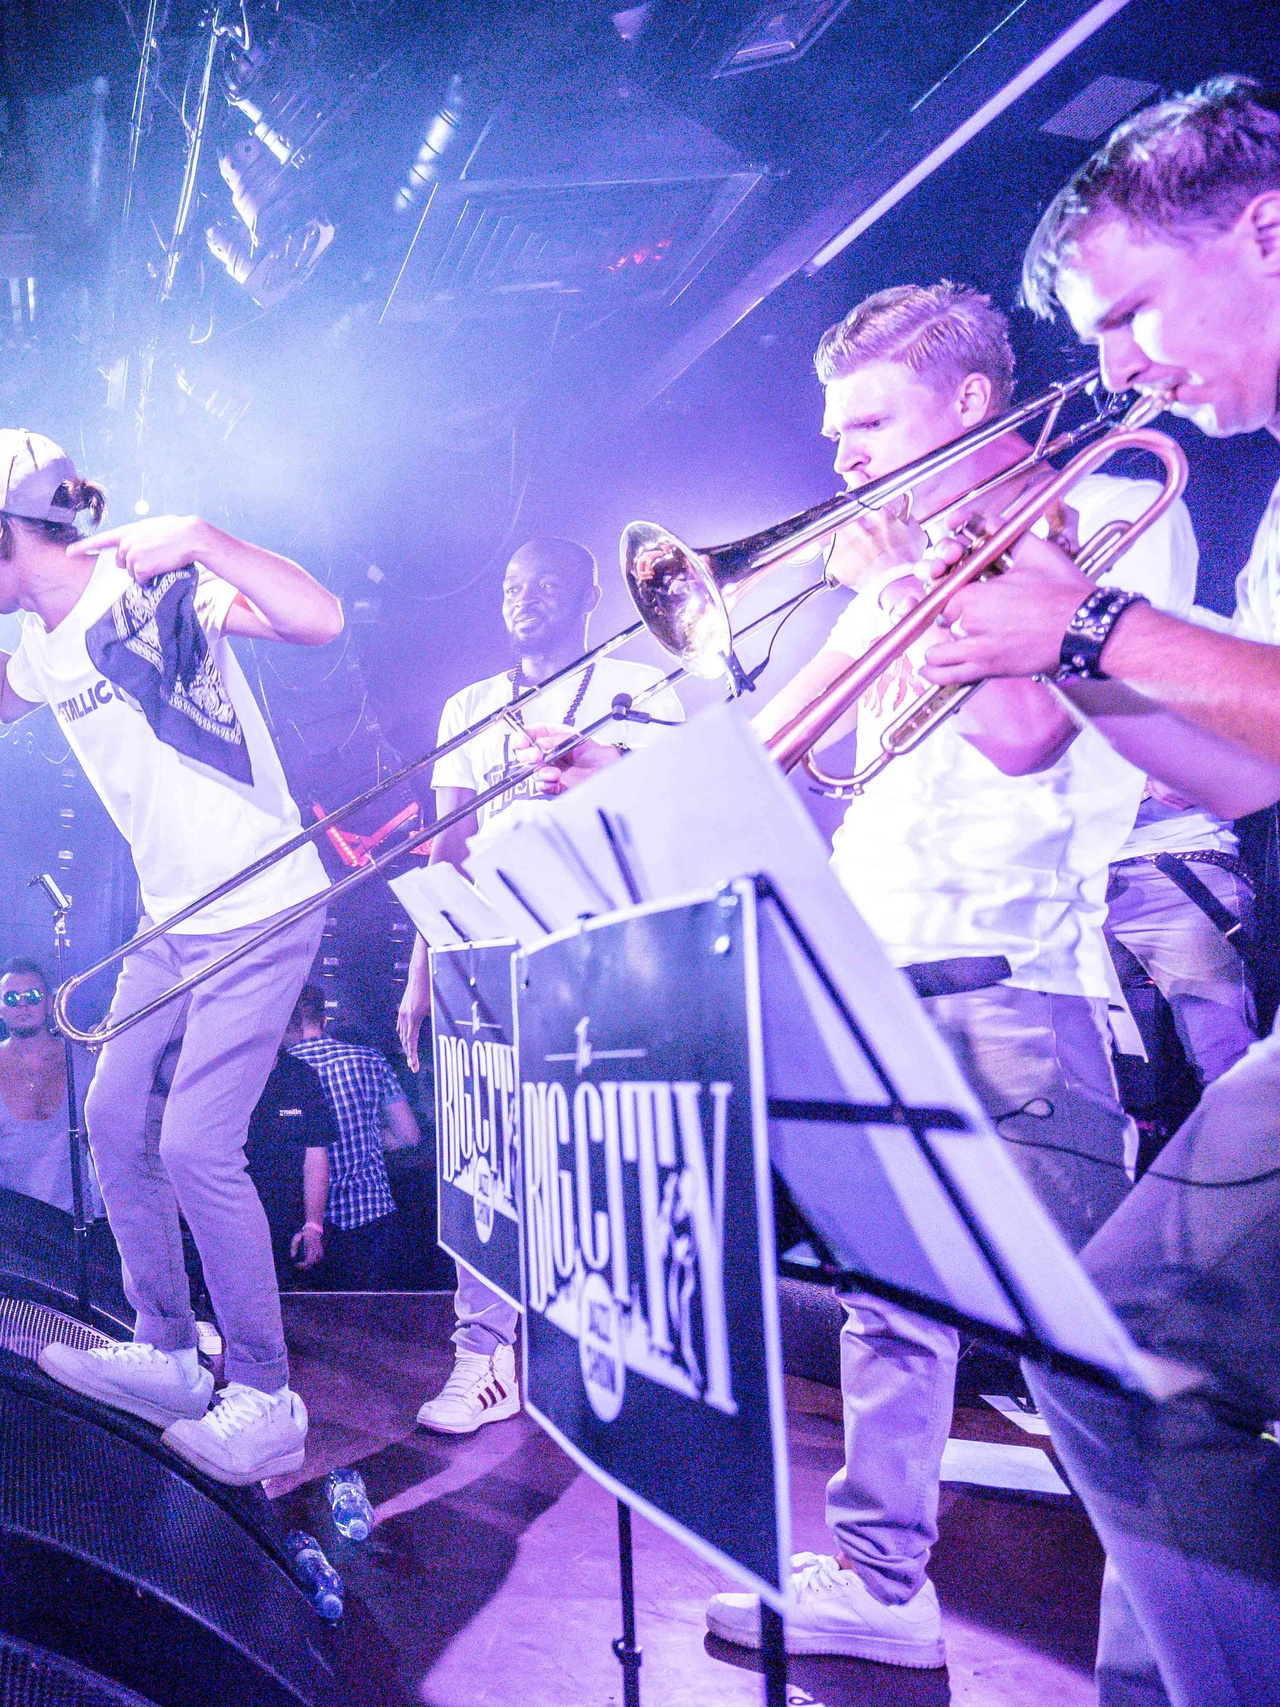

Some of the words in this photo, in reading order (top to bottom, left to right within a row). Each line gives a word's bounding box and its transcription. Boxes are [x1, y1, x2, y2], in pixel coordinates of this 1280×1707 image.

[57, 679, 126, 724] TALLIC
[437, 1034, 471, 1183] BIG
[522, 1081, 575, 1314] BIG
[574, 1080, 739, 1416] CITY
